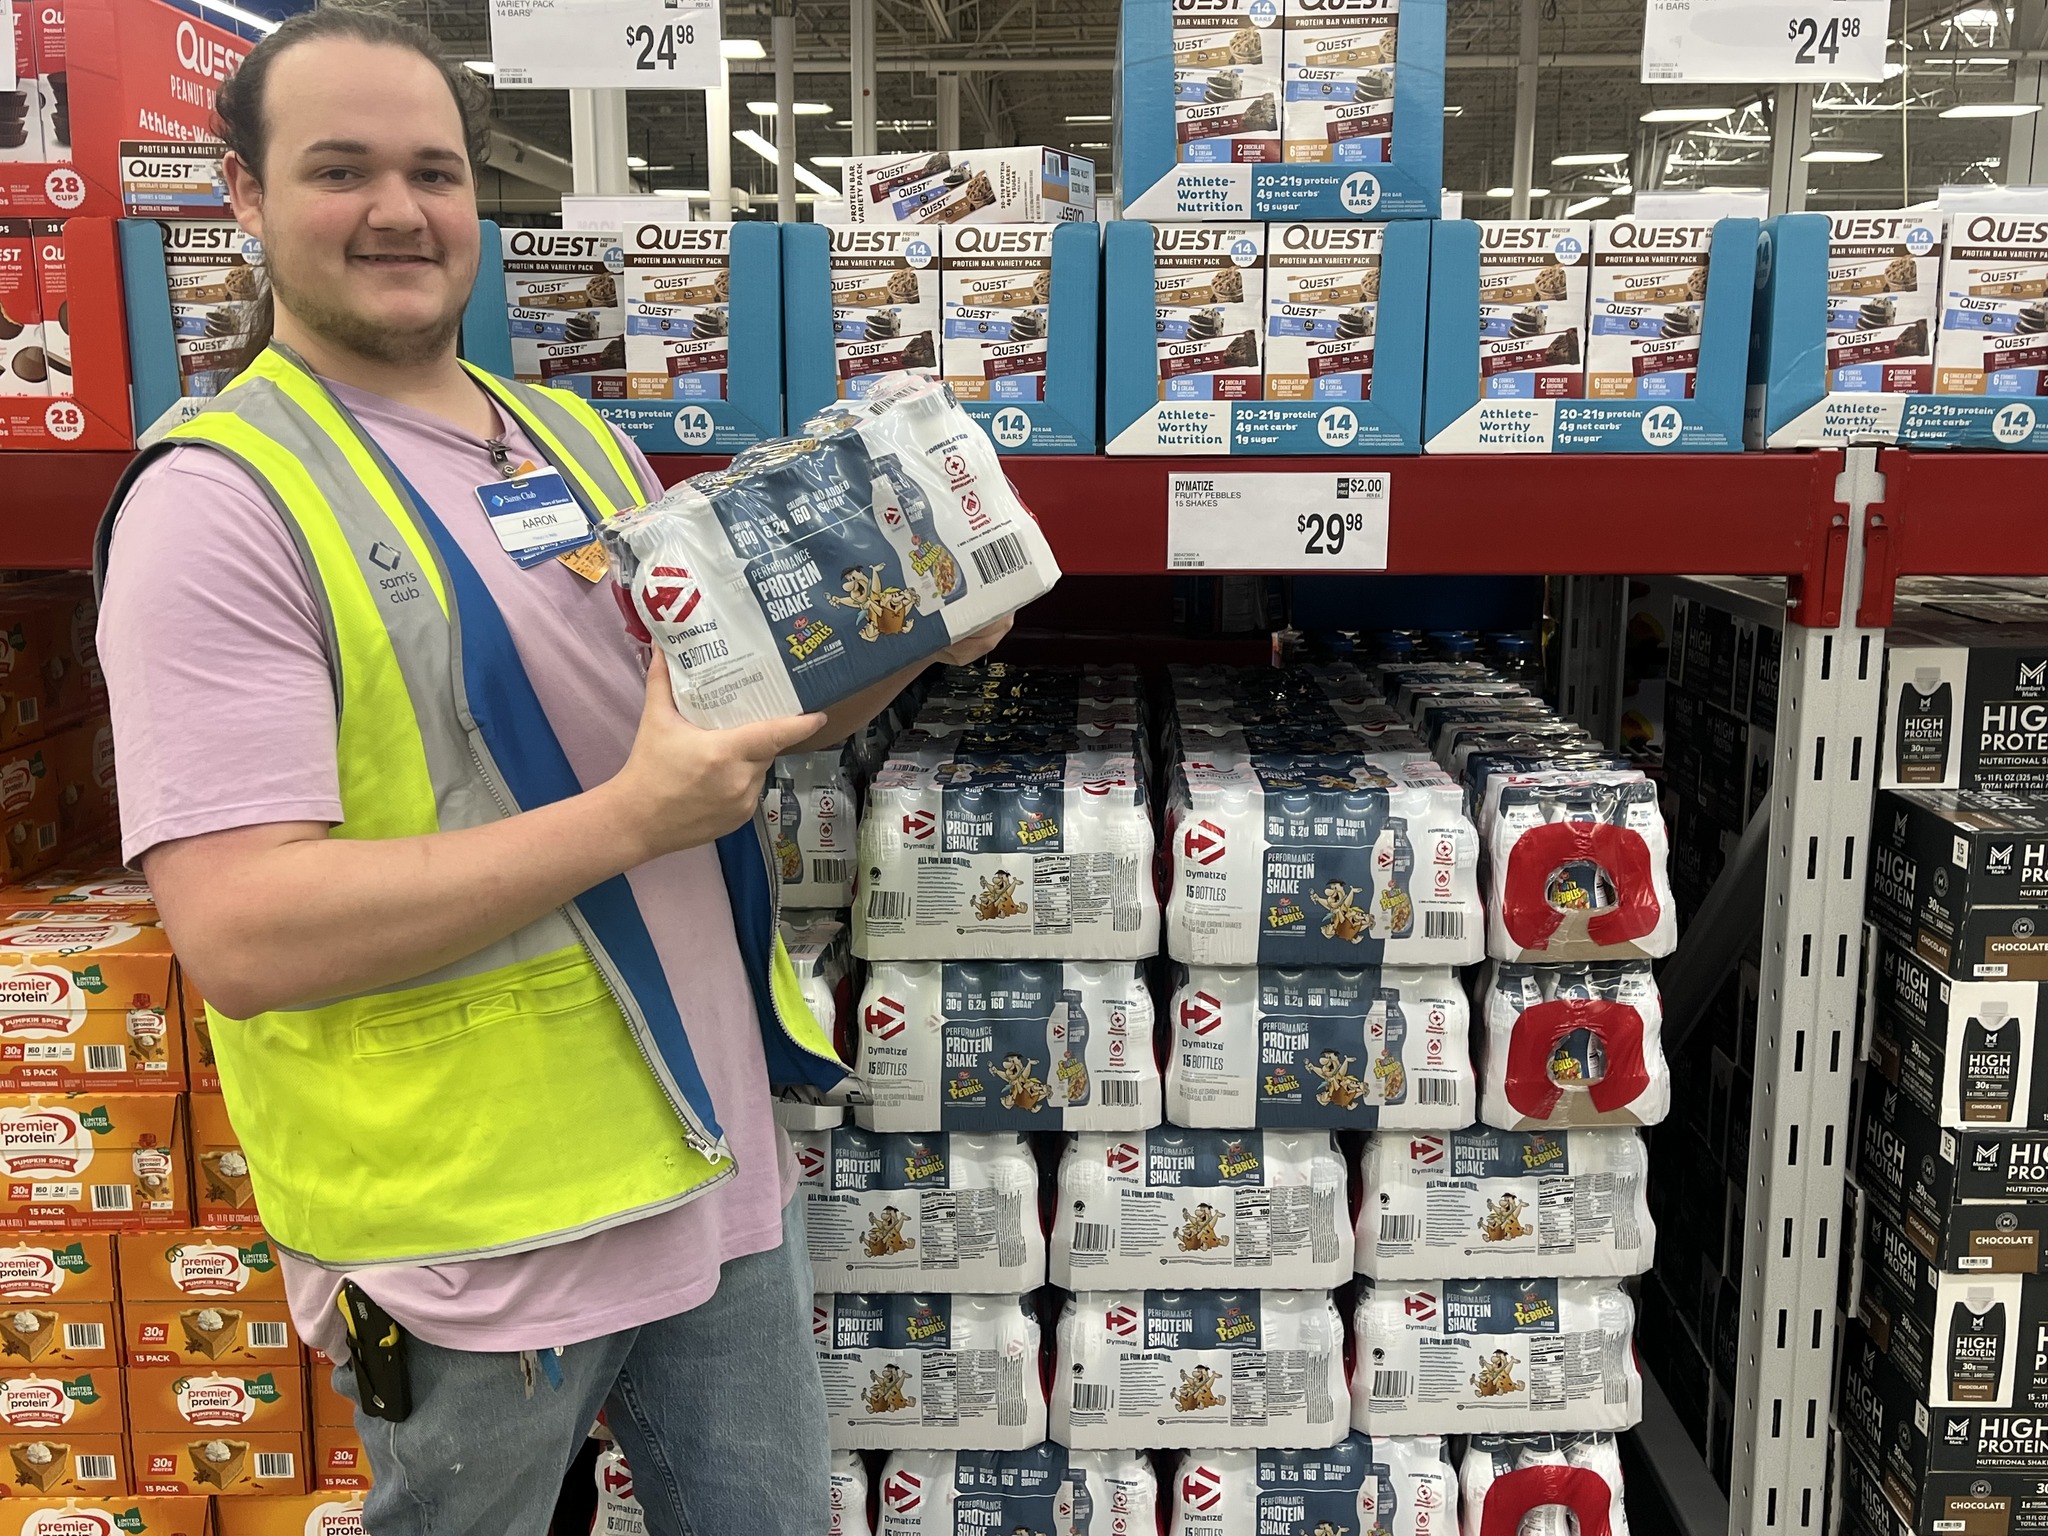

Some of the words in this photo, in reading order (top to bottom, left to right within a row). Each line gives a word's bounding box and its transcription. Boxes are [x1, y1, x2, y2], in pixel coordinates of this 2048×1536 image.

[1254, 2, 1272, 14] 14
[1666, 3, 1690, 11] BARS
[1296, 17, 1326, 26] PROTEIN
[1326, 17, 1340, 26] BAR
[1342, 17, 1368, 26] VARIETY
[1371, 16, 1388, 25] PACK
[170, 74, 202, 108] PEANUT
[139, 145, 167, 154] PROTEIN
[170, 146, 185, 154] BAR
[129, 159, 193, 179] QUEST
[850, 165, 858, 181] BAR
[857, 162, 866, 185] PACK
[51, 177, 79, 193] 28
[1177, 176, 1236, 188] Athlete-
[1257, 176, 1301, 188] 20-21g
[1346, 179, 1374, 198] 14
[55, 193, 78, 202] CUPS
[1176, 188, 1228, 202] Worthy
[1257, 188, 1271, 201] 4g
[1274, 189, 1290, 199] net
[850, 183, 858, 222] PROTEIN
[858, 188, 866, 223] VARIETY
[1177, 200, 1244, 212] Nutrition
[1256, 202, 1269, 214] 1g
[1348, 198, 1372, 207] BARS
[636, 225, 727, 249] QUEST
[955, 228, 1047, 253] QUEST
[1283, 225, 1375, 250] QUEST
[1609, 223, 1703, 249] QUEST
[1911, 231, 1928, 241] 14
[510, 231, 598, 256] QUEST
[909, 245, 926, 255] 14
[1235, 244, 1251, 253] 14
[1559, 242, 1576, 252] 14
[608, 250, 623, 260] 14
[1158, 411, 1215, 419] Athlete-
[1826, 404, 1887, 413] Athlete-
[51, 412, 79, 427] 28
[680, 414, 708, 430] 14
[999, 415, 1024, 431] 14
[1324, 415, 1352, 431] 14
[1648, 414, 1676, 430] 14
[1826, 416, 1877, 426] Worthy
[2000, 411, 2029, 427] 14
[55, 426, 78, 435] CUPS
[1158, 423, 1208, 433] Worthy
[925, 433, 968, 457] FORMULATED
[1158, 435, 1222, 444] Nutrition
[1175, 481, 1213, 491] DYMATIZE
[1350, 479, 1382, 492] $2.00
[522, 491, 536, 500] Club
[812, 492, 824, 506] NO
[824, 480, 850, 501] ADDED
[522, 514, 558, 529] AARON
[790, 506, 811, 526] 160
[765, 519, 788, 540] 6.2g
[734, 525, 758, 550] 30g
[751, 551, 812, 581] PERFORMANCE
[380, 572, 417, 590] sam's
[757, 560, 823, 603] PROTEIN
[390, 588, 420, 604] club
[767, 591, 812, 623] SHAKE
[788, 624, 833, 661] PEBBLES
[677, 652, 694, 670] 15
[692, 640, 729, 666] BOTTLES
[1906, 718, 1944, 730] HIGH
[1904, 728, 1943, 739] PROTEIN
[946, 821, 993, 836] PROTEIN
[1017, 824, 1058, 846] PEBBLES
[946, 836, 979, 850] SHAKE
[1956, 842, 1964, 855] 15
[1268, 853, 1315, 863] PERFORMANCE
[1267, 864, 1315, 879] PROTEIN
[1876, 845, 1917, 891] HIGH
[1186, 885, 1194, 899] 15
[1195, 887, 1226, 901] BOTTLES
[1266, 879, 1299, 894] SHAKE
[1874, 872, 1915, 911] PROTEIN
[1920, 934, 1948, 958] CHOCOLATE
[1263, 1033, 1309, 1050] PROTEIN
[1263, 1049, 1294, 1064] SHAKE
[1969, 1053, 2011, 1067] HIGH
[22, 1068, 31, 1077] 15
[32, 1068, 58, 1077] PACK
[868, 1062, 875, 1075] 15
[877, 1063, 907, 1076] BOTTLES
[1968, 1065, 2010, 1075] PROTEIN
[1975, 1081, 1989, 1090] 30g
[1, 1120, 59, 1134] premier
[1455, 1146, 1499, 1160] PROTEIN
[1150, 1156, 1194, 1170] PROTEIN
[1455, 1161, 1484, 1176] SHAKE
[1150, 1170, 1180, 1184] SHAKE
[1976, 1236, 2034, 1245] CHOCOLATE
[182, 1258, 226, 1270] premier
[243, 1257, 268, 1265] EDITION
[1148, 1318, 1192, 1332] PROTEIN
[144, 1327, 164, 1338] 30g
[1148, 1332, 1178, 1348] SHAKE
[1956, 1337, 1997, 1349] HIGH
[146, 1355, 170, 1363] PACK
[1955, 1348, 1996, 1357] PROTEIN
[1951, 1502, 2006, 1510] CHOCOLATE
[38, 1521, 94, 1534] premier
